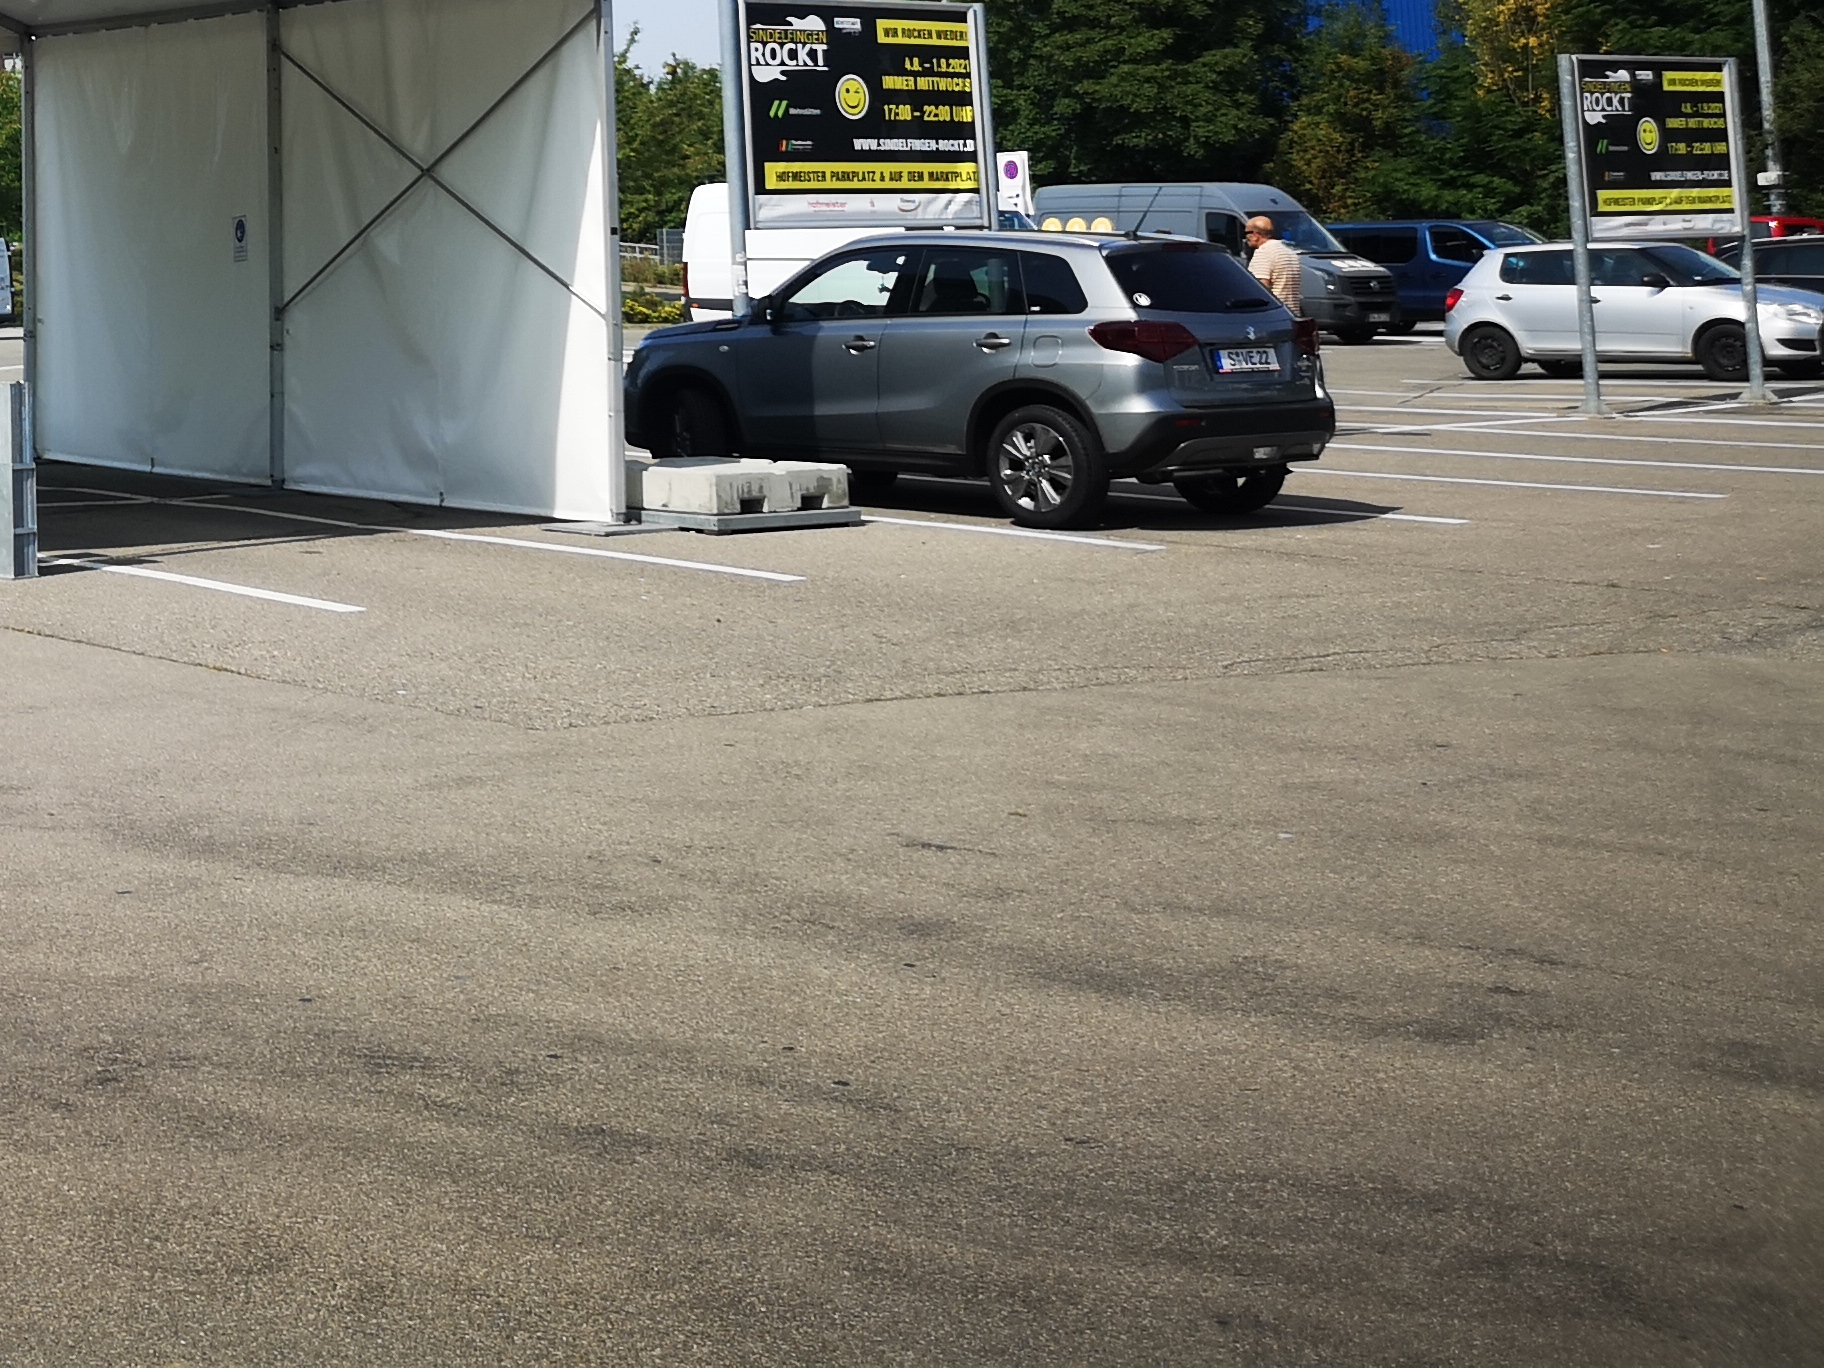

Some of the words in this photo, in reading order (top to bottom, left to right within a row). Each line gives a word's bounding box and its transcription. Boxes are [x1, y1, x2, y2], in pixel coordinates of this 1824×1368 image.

[749, 29, 827, 43] SINDELFINGEN
[882, 27, 898, 38] WIR
[901, 28, 933, 40] ROCKEN
[935, 29, 968, 42] WIEDER!
[749, 42, 828, 66] ROCKT
[932, 57, 970, 73] 1.9.2021
[882, 75, 914, 90] IMMER
[916, 76, 972, 92] MITTWOCHS
[1583, 92, 1632, 111] ROCKT
[883, 104, 912, 121] 17:00
[923, 105, 951, 121] 22:00
[853, 138, 975, 152] WWW.SINDELFINGEN-ROCKT.D
[775, 170, 827, 183] HOFMEISTER
[830, 170, 876, 183] PARKPLATZ
[879, 170, 886, 182] &
[889, 170, 904, 182] AUF
[907, 170, 925, 182] DEM
[927, 170, 978, 183] MARKTPLAT
